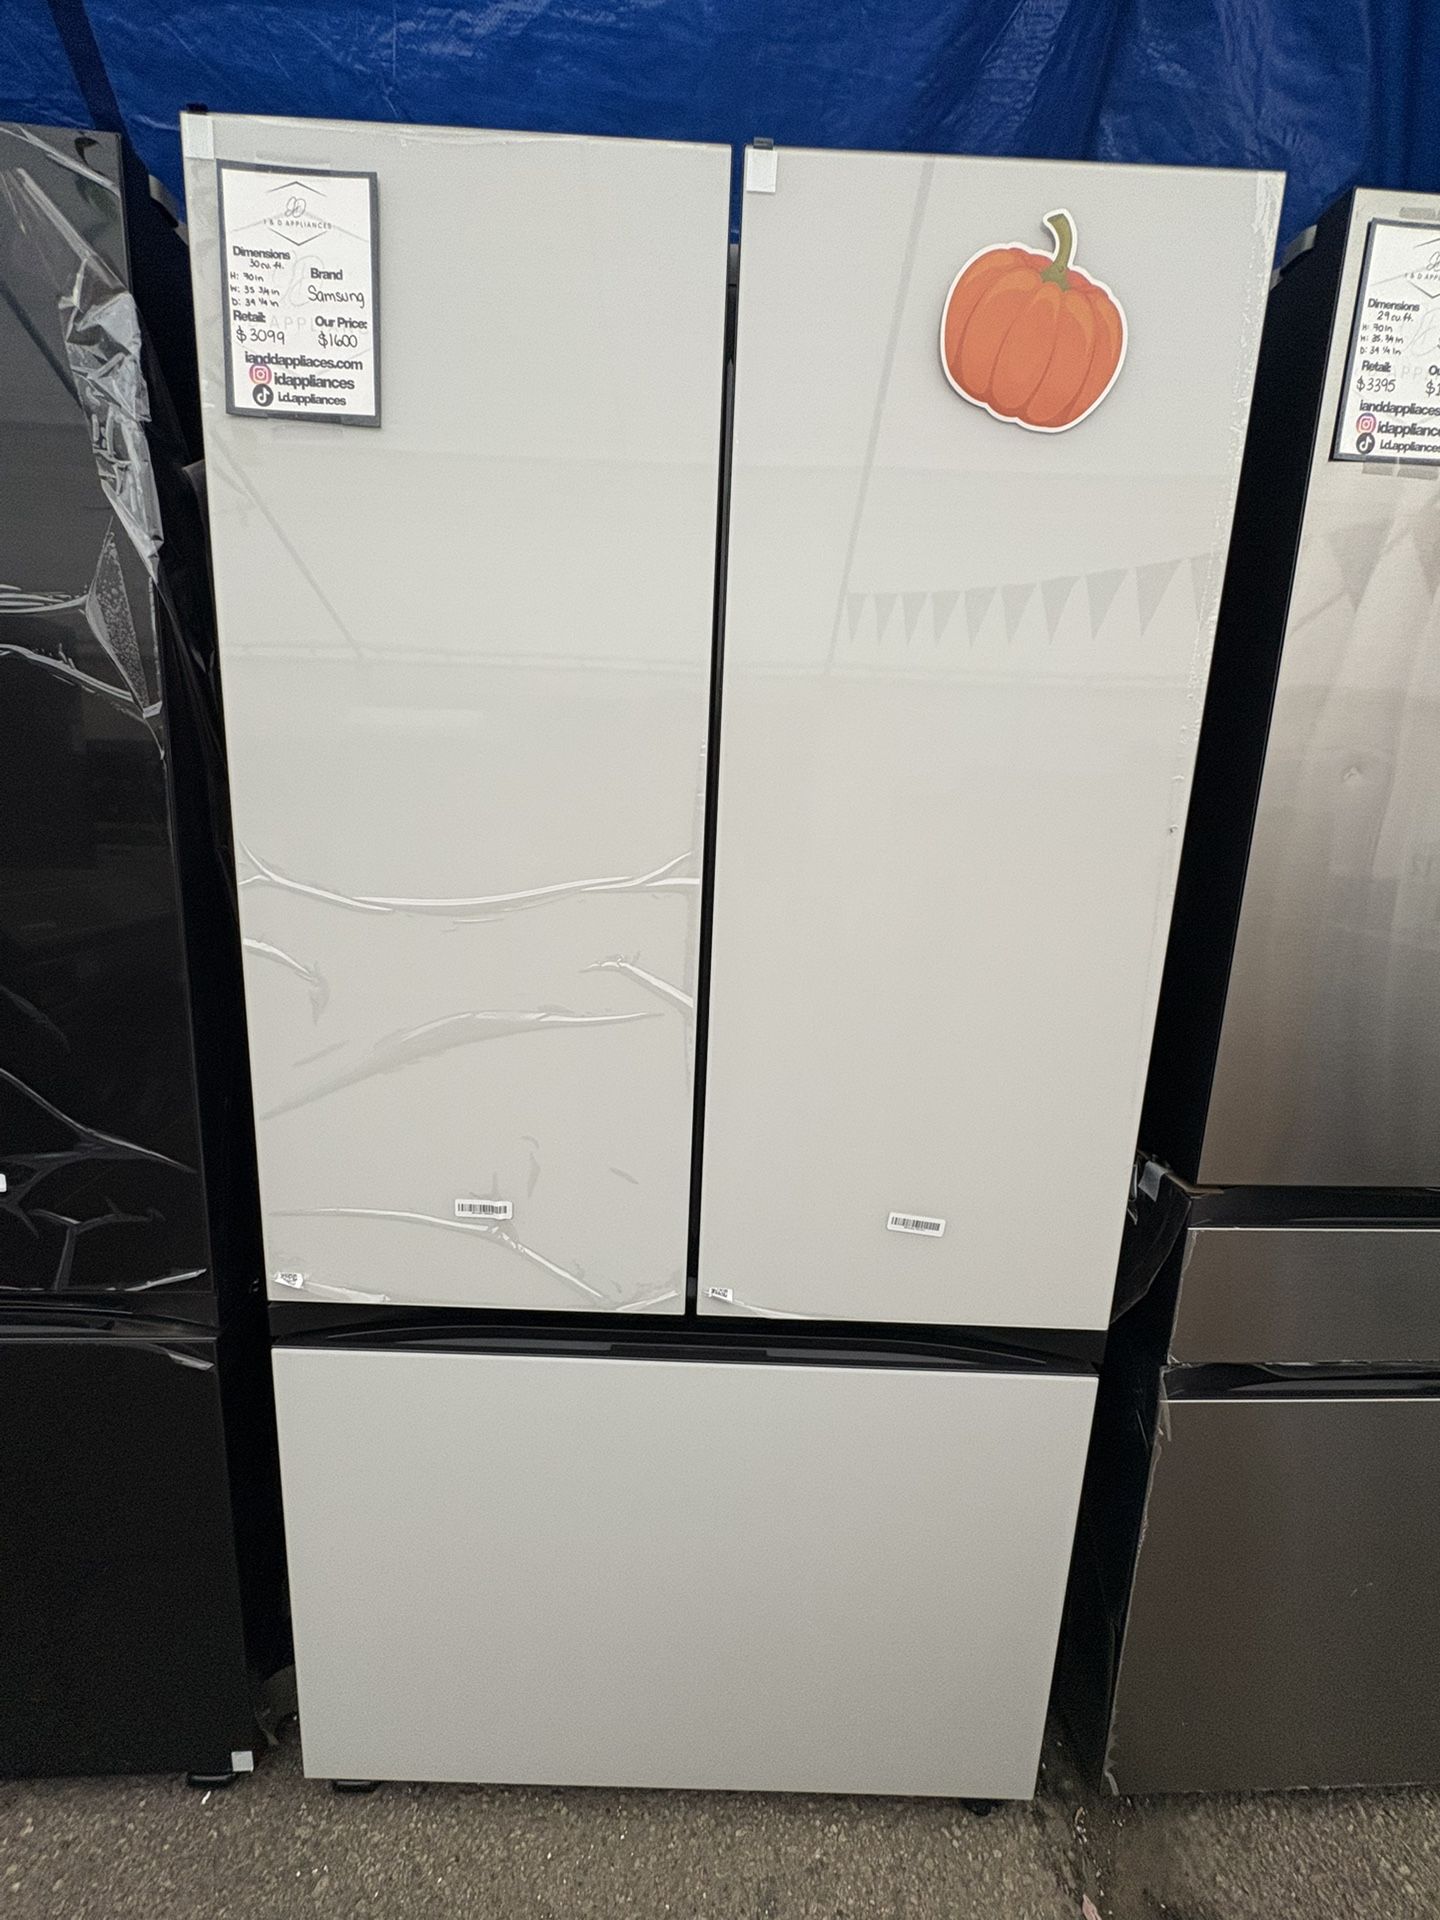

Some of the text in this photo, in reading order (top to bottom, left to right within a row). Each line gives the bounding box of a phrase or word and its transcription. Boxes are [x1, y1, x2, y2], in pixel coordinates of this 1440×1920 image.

[285, 220, 333, 230] APPLIANCES
[232, 245, 291, 261] Dimensions
[310, 267, 343, 281] Brand
[307, 284, 365, 309] Samsung
[1367, 298, 1420, 312] Dimensions
[315, 315, 335, 328] Our
[337, 317, 368, 330] Price:
[236, 325, 285, 345] $3099
[318, 331, 358, 349] $1600
[245, 351, 363, 370] ianddappliaces.com
[274, 372, 355, 390] idappliances
[1356, 375, 1396, 393] $3395
